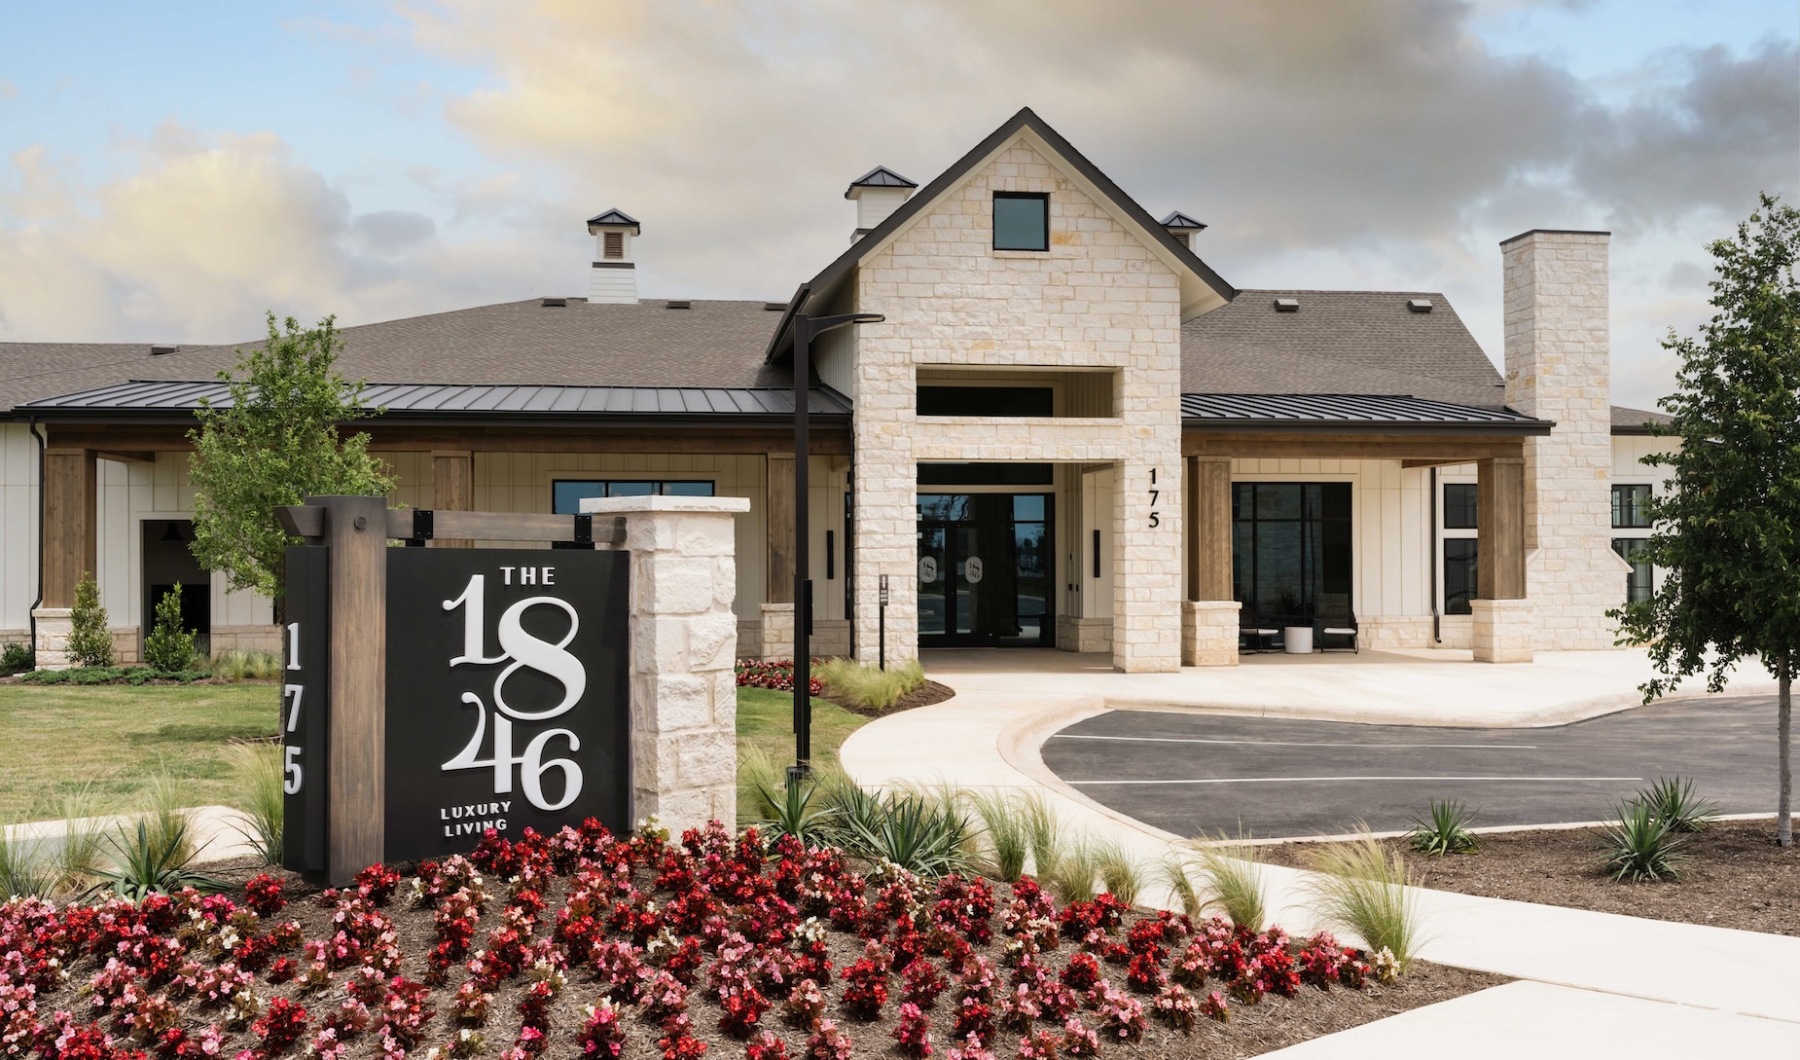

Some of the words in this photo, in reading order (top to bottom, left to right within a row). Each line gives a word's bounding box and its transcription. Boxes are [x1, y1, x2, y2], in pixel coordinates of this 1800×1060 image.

[1148, 467, 1160, 529] 175
[500, 566, 556, 586] THE
[284, 622, 304, 795] 175
[440, 801, 512, 820] LUXURY
[444, 818, 507, 837] LIVING
